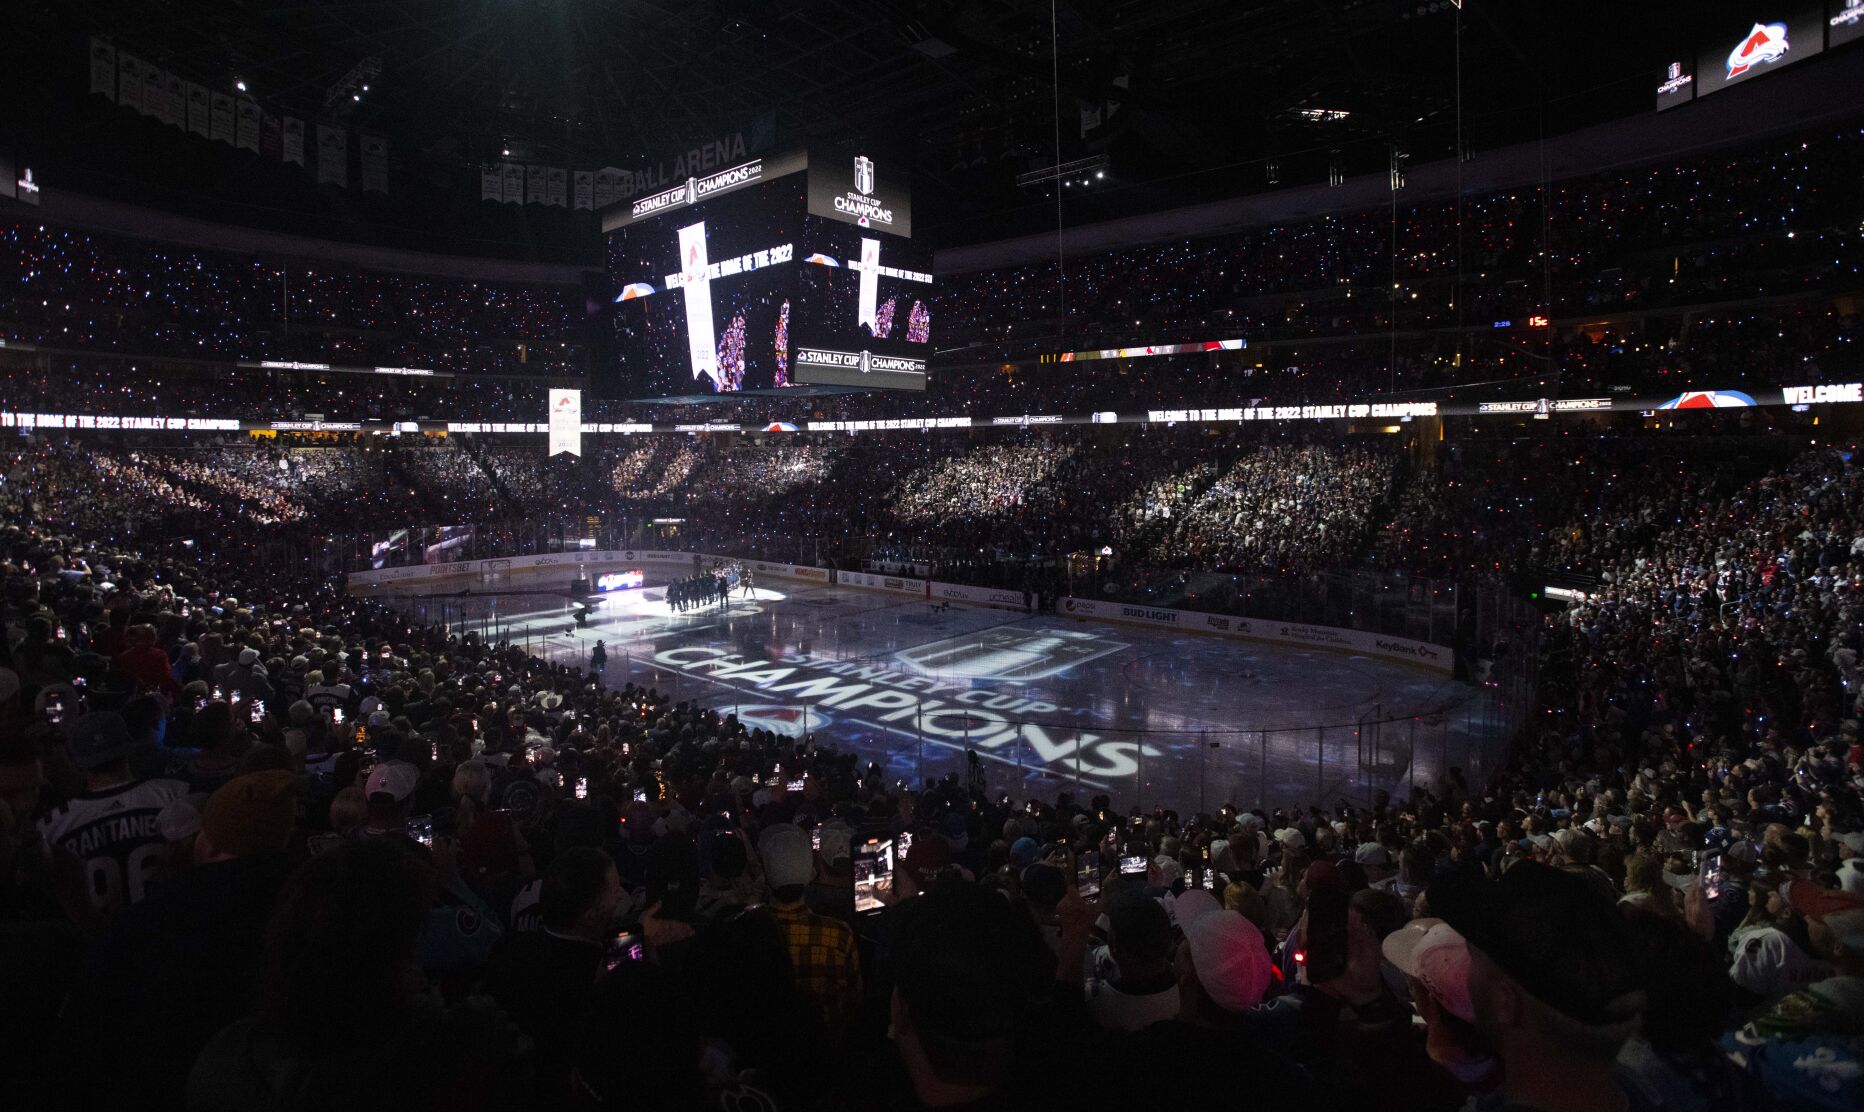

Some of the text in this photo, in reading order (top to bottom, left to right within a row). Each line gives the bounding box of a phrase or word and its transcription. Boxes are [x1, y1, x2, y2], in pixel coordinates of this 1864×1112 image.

[624, 162, 669, 196] BALL
[673, 132, 747, 181] ARENA
[640, 165, 762, 212] STANLEY CUP CHAMPIONS 2022
[848, 192, 882, 206] STANLEY CUP
[834, 196, 892, 222] CHAMPIONS
[720, 257, 742, 276] HOME
[742, 254, 752, 271] OF
[752, 250, 770, 268] THE
[770, 243, 793, 265] 2022
[913, 272, 924, 282] 2022
[808, 352, 843, 365] STANLEY
[844, 356, 859, 365] CUP
[872, 358, 915, 371] CHAMPIONS
[1782, 383, 1862, 404] WELCOME
[1150, 402, 1436, 422] WELCOME TO THE HOME OF THE 2022 STANLEY CUP CHAMPIONS
[1488, 403, 1521, 411] STANLEY
[1522, 402, 1537, 410] CUP
[1549, 400, 1598, 409] CHAMPIONS
[1, 412, 240, 430] TO THE HOME OF THE 2022 STANLEY CUP CHAMPIONS
[448, 423, 481, 432] WELCOME
[482, 423, 491, 432] TO
[492, 423, 505, 432] THE
[506, 423, 526, 432] HOME
[527, 423, 535, 432] OF
[537, 423, 549, 432] THE
[599, 424, 613, 432] CUP
[614, 424, 652, 432] CHAMPIONS
[808, 417, 971, 431] WELCOME TO THE HOME OF THE 2022 STANLEY CUP CHAMPIONS
[431, 563, 470, 574] POINTSBET
[1076, 602, 1096, 610] pepsi
[1123, 608, 1177, 622] BUD LIGHT
[1376, 640, 1417, 655] KeyBank
[786, 654, 959, 695] STANLEY
[956, 690, 1058, 714] CUP
[655, 647, 1164, 777] CHAMPIONS
[64, 815, 158, 858] RANTANE
